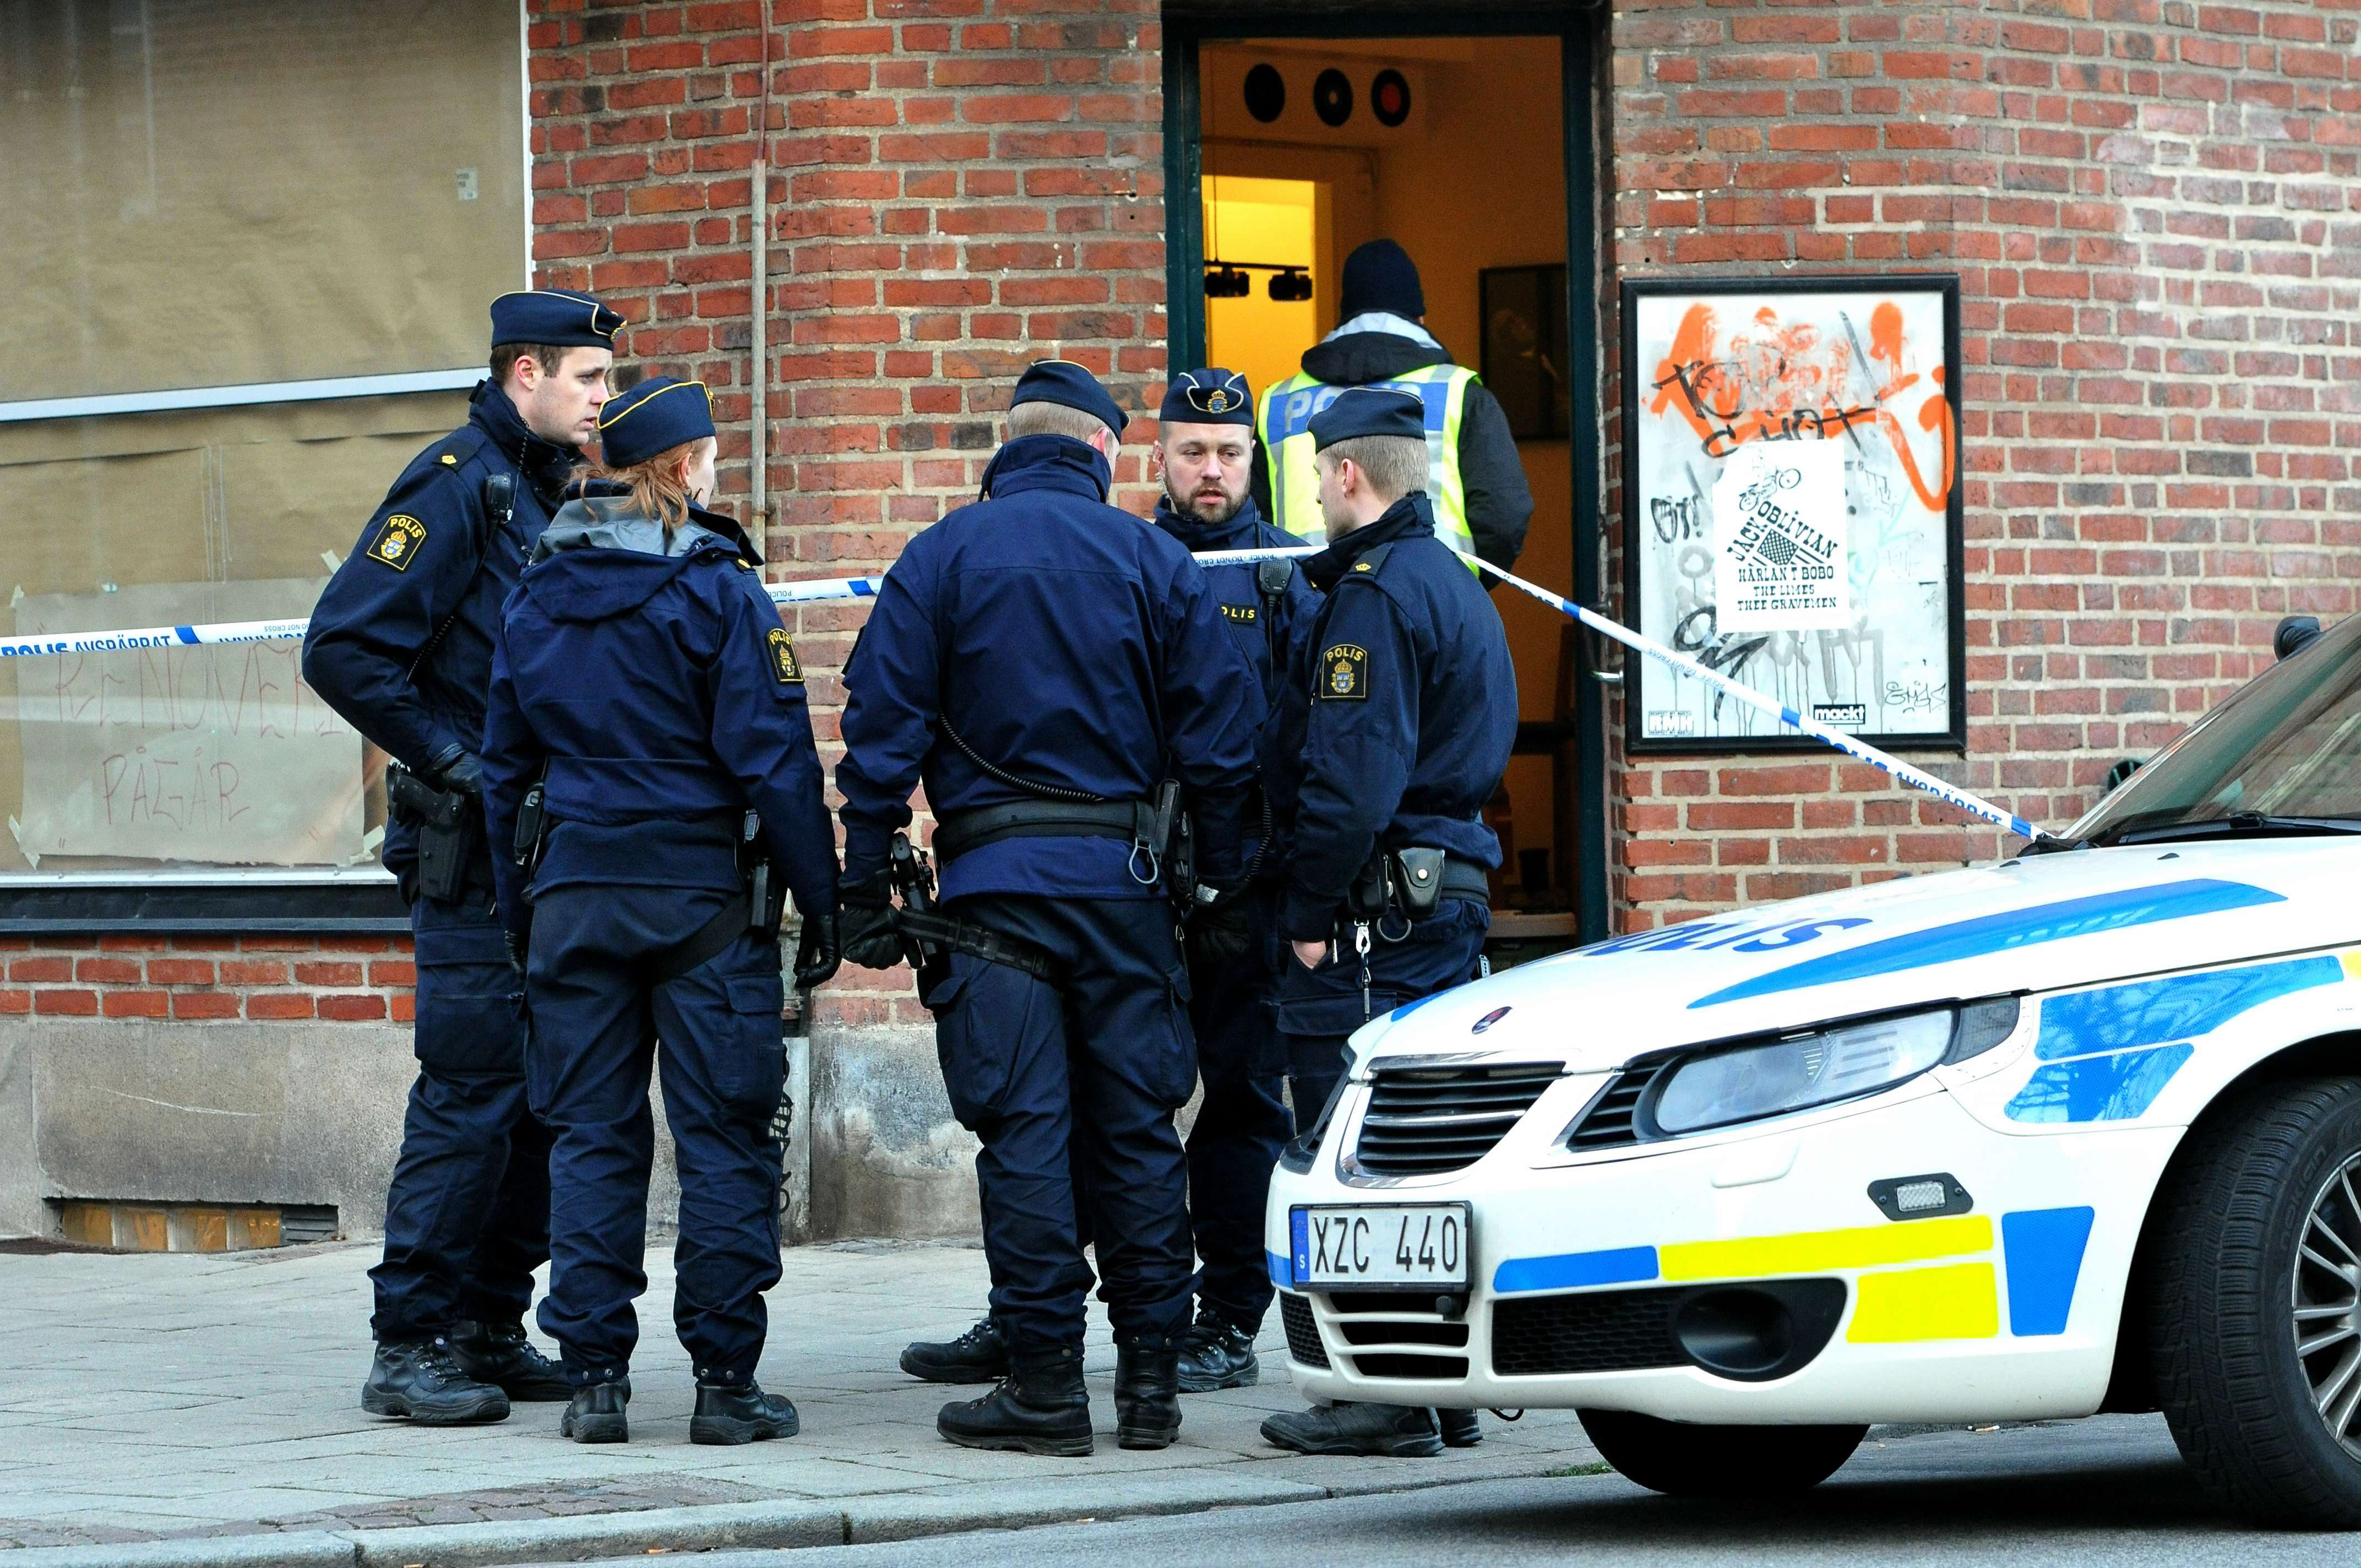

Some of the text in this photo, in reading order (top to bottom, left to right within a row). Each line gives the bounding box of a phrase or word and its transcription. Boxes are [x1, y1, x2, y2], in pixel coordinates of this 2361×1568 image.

[390, 518, 422, 538] POLIS
[1727, 516, 1769, 562] JACK
[1738, 565, 1834, 582] HARLAN T BOBO
[1753, 584, 1815, 596] THE LIMES
[1738, 597, 1836, 611] THEE GRAVEMEN
[1221, 606, 1255, 618] OLIS
[769, 631, 790, 645] POLIS
[1326, 647, 1364, 662] POLIS
[1814, 705, 1864, 720] mackt
[1649, 715, 1692, 731] RMH
[102, 745, 250, 831] PÅGÅR
[1313, 1215, 1457, 1273] XZC 440
[1299, 1254, 1305, 1269] S
